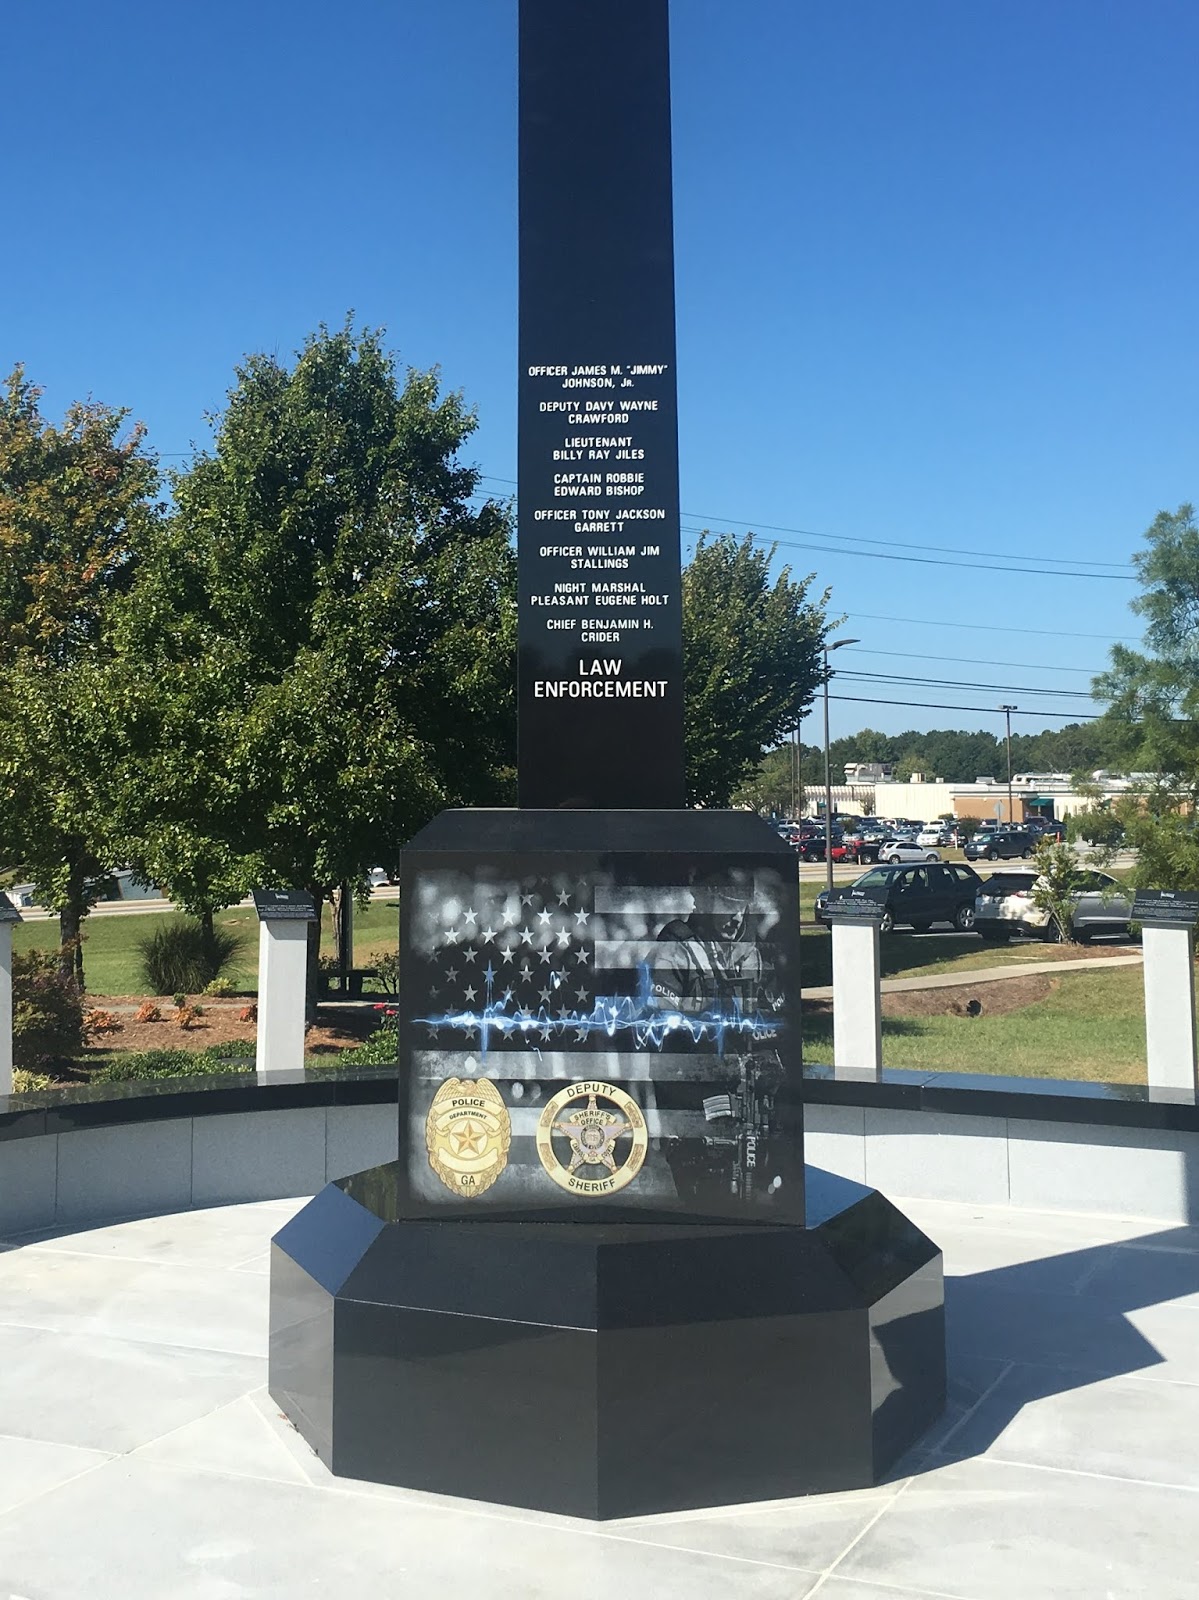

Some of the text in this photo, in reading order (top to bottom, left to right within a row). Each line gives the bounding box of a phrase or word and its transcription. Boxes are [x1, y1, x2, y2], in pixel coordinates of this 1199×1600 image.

[528, 365, 668, 376] OFFICER JAMES M. "JIMMY"
[562, 379, 615, 388] JOHNSON,
[540, 401, 658, 412] DEPUTY DAVY WAYNE
[568, 414, 628, 424] CRAWFORD
[565, 437, 632, 447] LIEUTENANT
[553, 450, 644, 460] BILLY RAY JILES
[554, 473, 644, 484] CAPTAIN ROBBIE
[554, 486, 644, 496] EDWARD BISHOP
[534, 509, 665, 520] OFFICER TONY JACKSON
[575, 522, 624, 532] GARRETT
[540, 546, 659, 556] OFFICER WILLIAM JIM
[571, 559, 628, 569] STALLINGS
[555, 583, 645, 593] NIGHT MARSHAL
[531, 595, 668, 606] PLEASANT EUGENE HOLT
[547, 619, 653, 629] CHIEF BENJAMIN H.
[581, 632, 620, 642] CRIDER
[579, 659, 622, 675] LAW
[534, 681, 668, 697] ENFORCEMENT
[567, 1084, 616, 1097] DEPUTY
[452, 1099, 485, 1107] POLICE
[450, 1111, 487, 1119] DEPARTMENT
[574, 1111, 611, 1120] SHERIFF'S
[746, 1136, 756, 1167] POLICE
[461, 1175, 475, 1185] GA
[568, 1178, 616, 1191] SHERIFF
